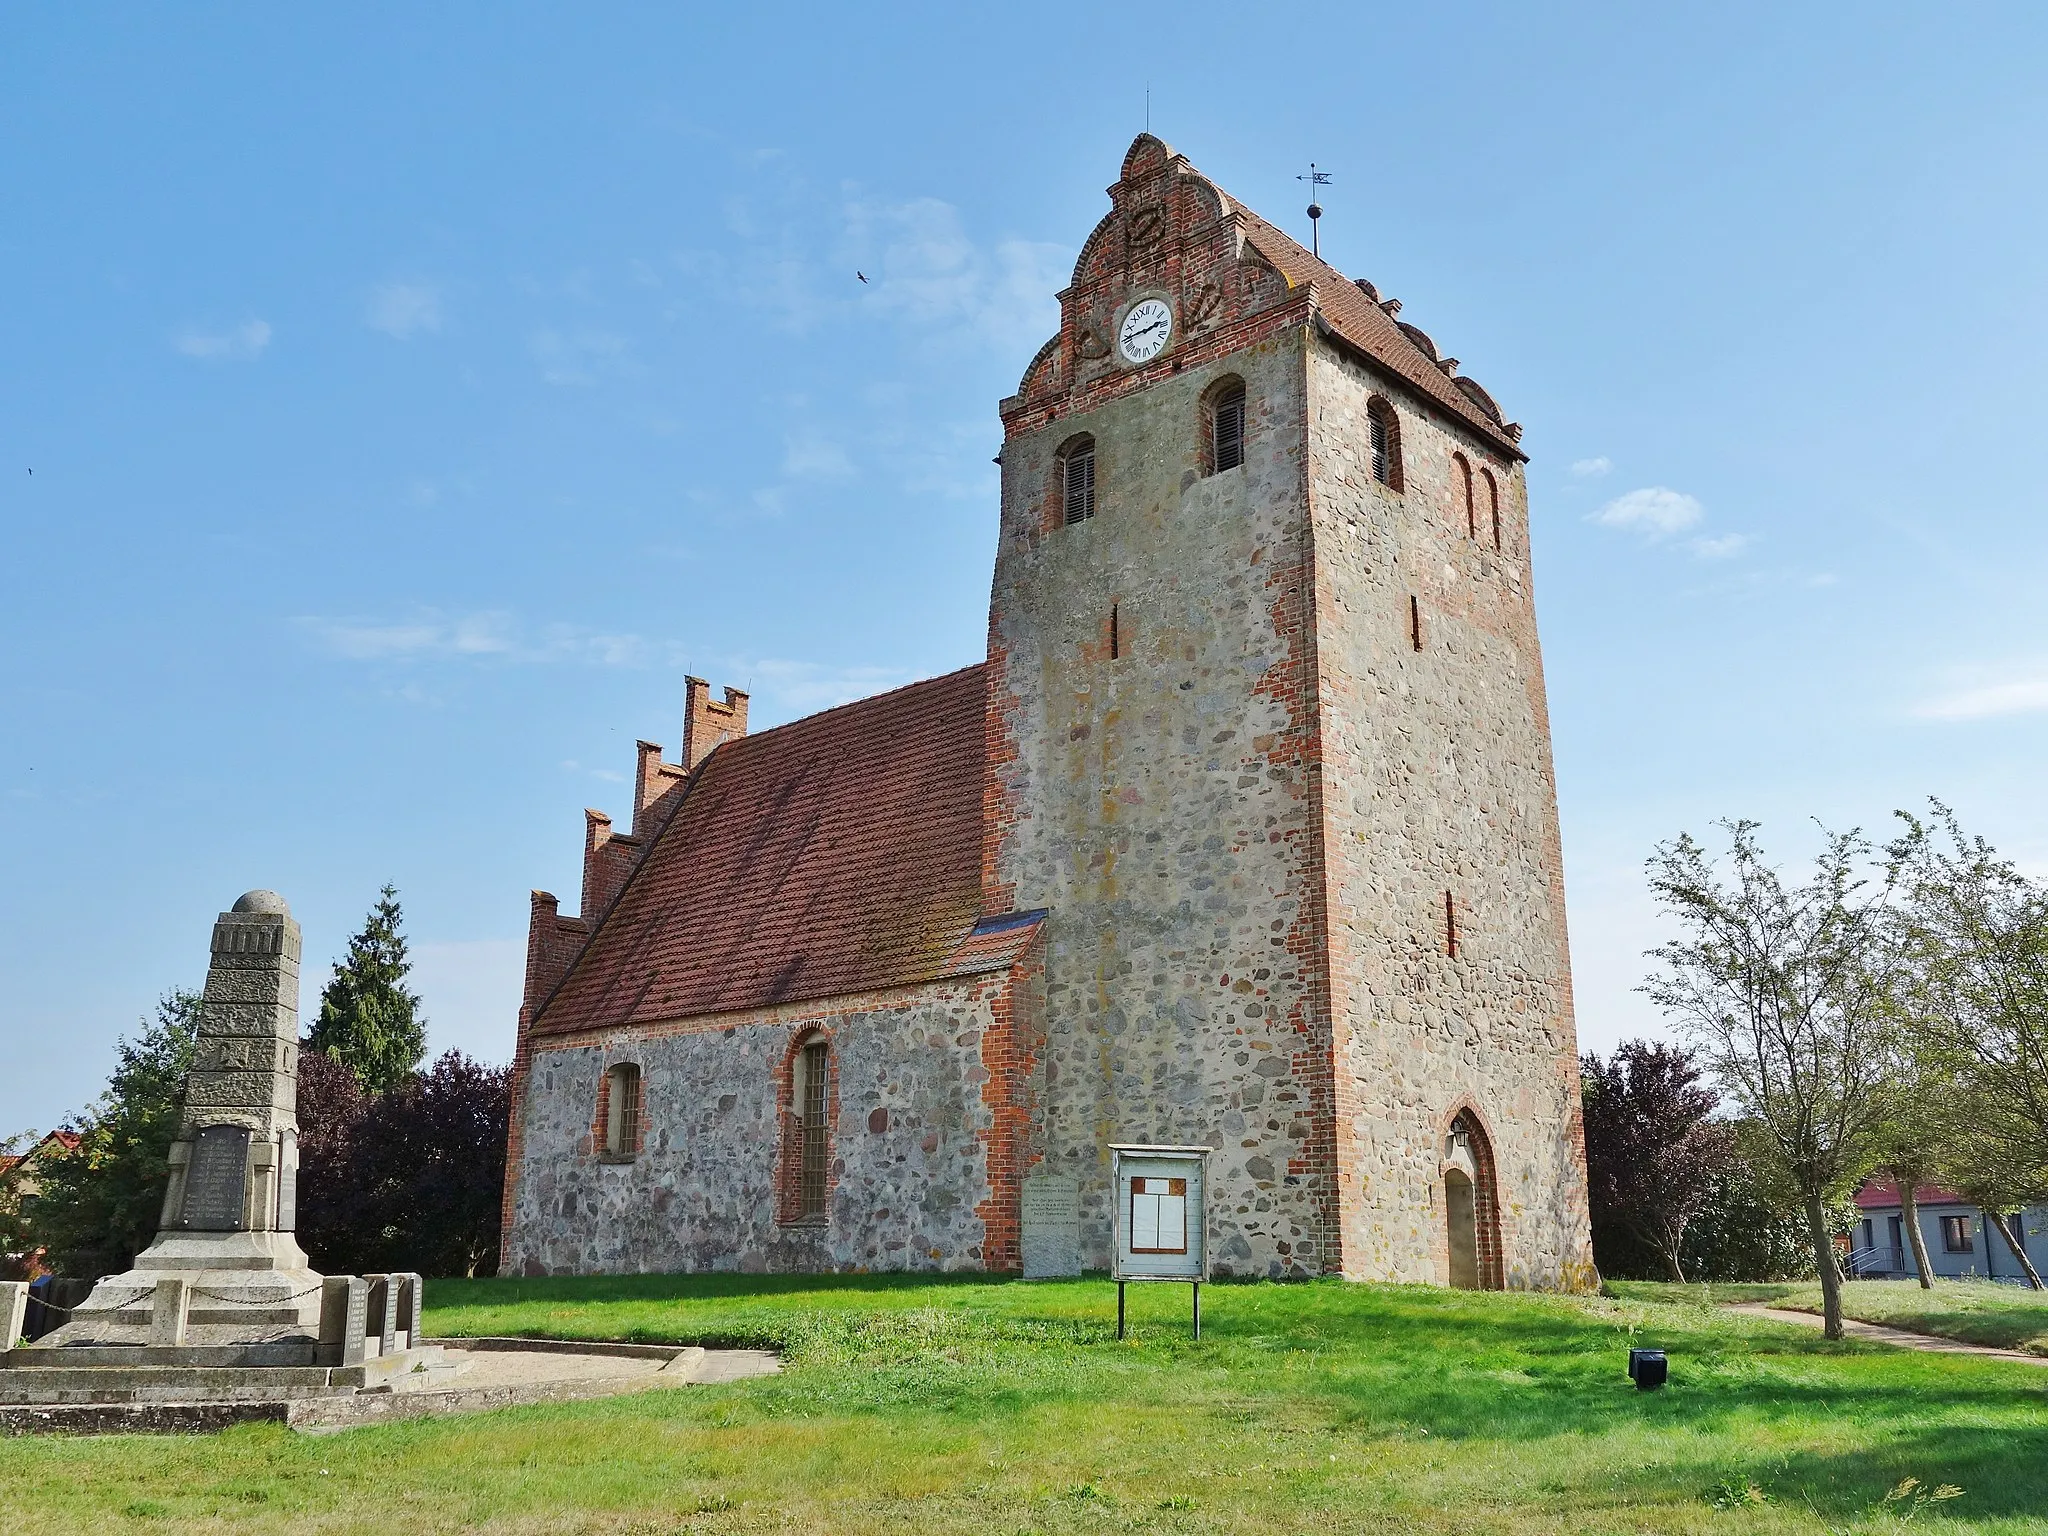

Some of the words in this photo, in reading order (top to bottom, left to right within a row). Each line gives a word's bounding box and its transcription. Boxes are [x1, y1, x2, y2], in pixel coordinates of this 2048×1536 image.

[1130, 311, 1141, 324] XI
[1156, 309, 1165, 319] II
[1152, 341, 1161, 350] V
